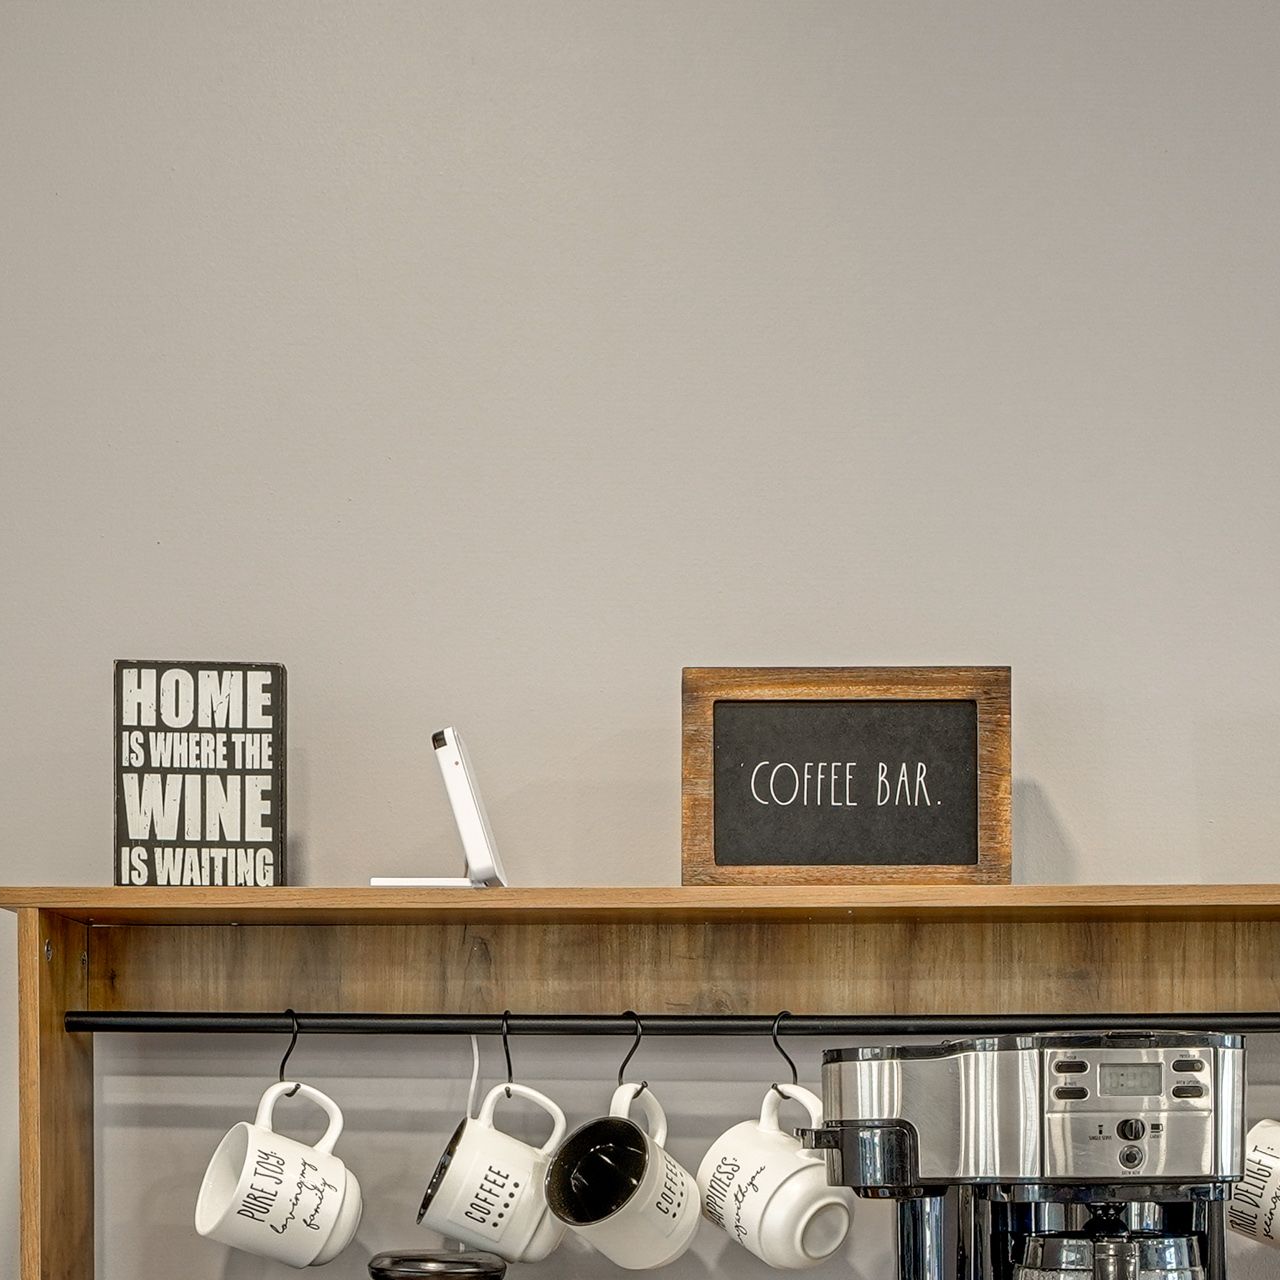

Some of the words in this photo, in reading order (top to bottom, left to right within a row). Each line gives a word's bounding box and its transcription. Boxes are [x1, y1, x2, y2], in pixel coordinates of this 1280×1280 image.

[122, 668, 273, 729] HOME
[122, 731, 145, 767] IS
[148, 731, 228, 769] WHERE
[231, 733, 273, 769] THE
[122, 773, 273, 842] WINE
[750, 761, 858, 806] COFFEE
[876, 762, 942, 806] BAR.
[121, 846, 148, 885] IS
[154, 847, 274, 887] WAITING
[236, 1182, 278, 1223] PURE
[269, 1180, 318, 1235] loving
[302, 1177, 338, 1231] family
[464, 1165, 511, 1224] COFFEE
[655, 1155, 678, 1215] COFFEE
[1227, 1205, 1258, 1237] TRUE
